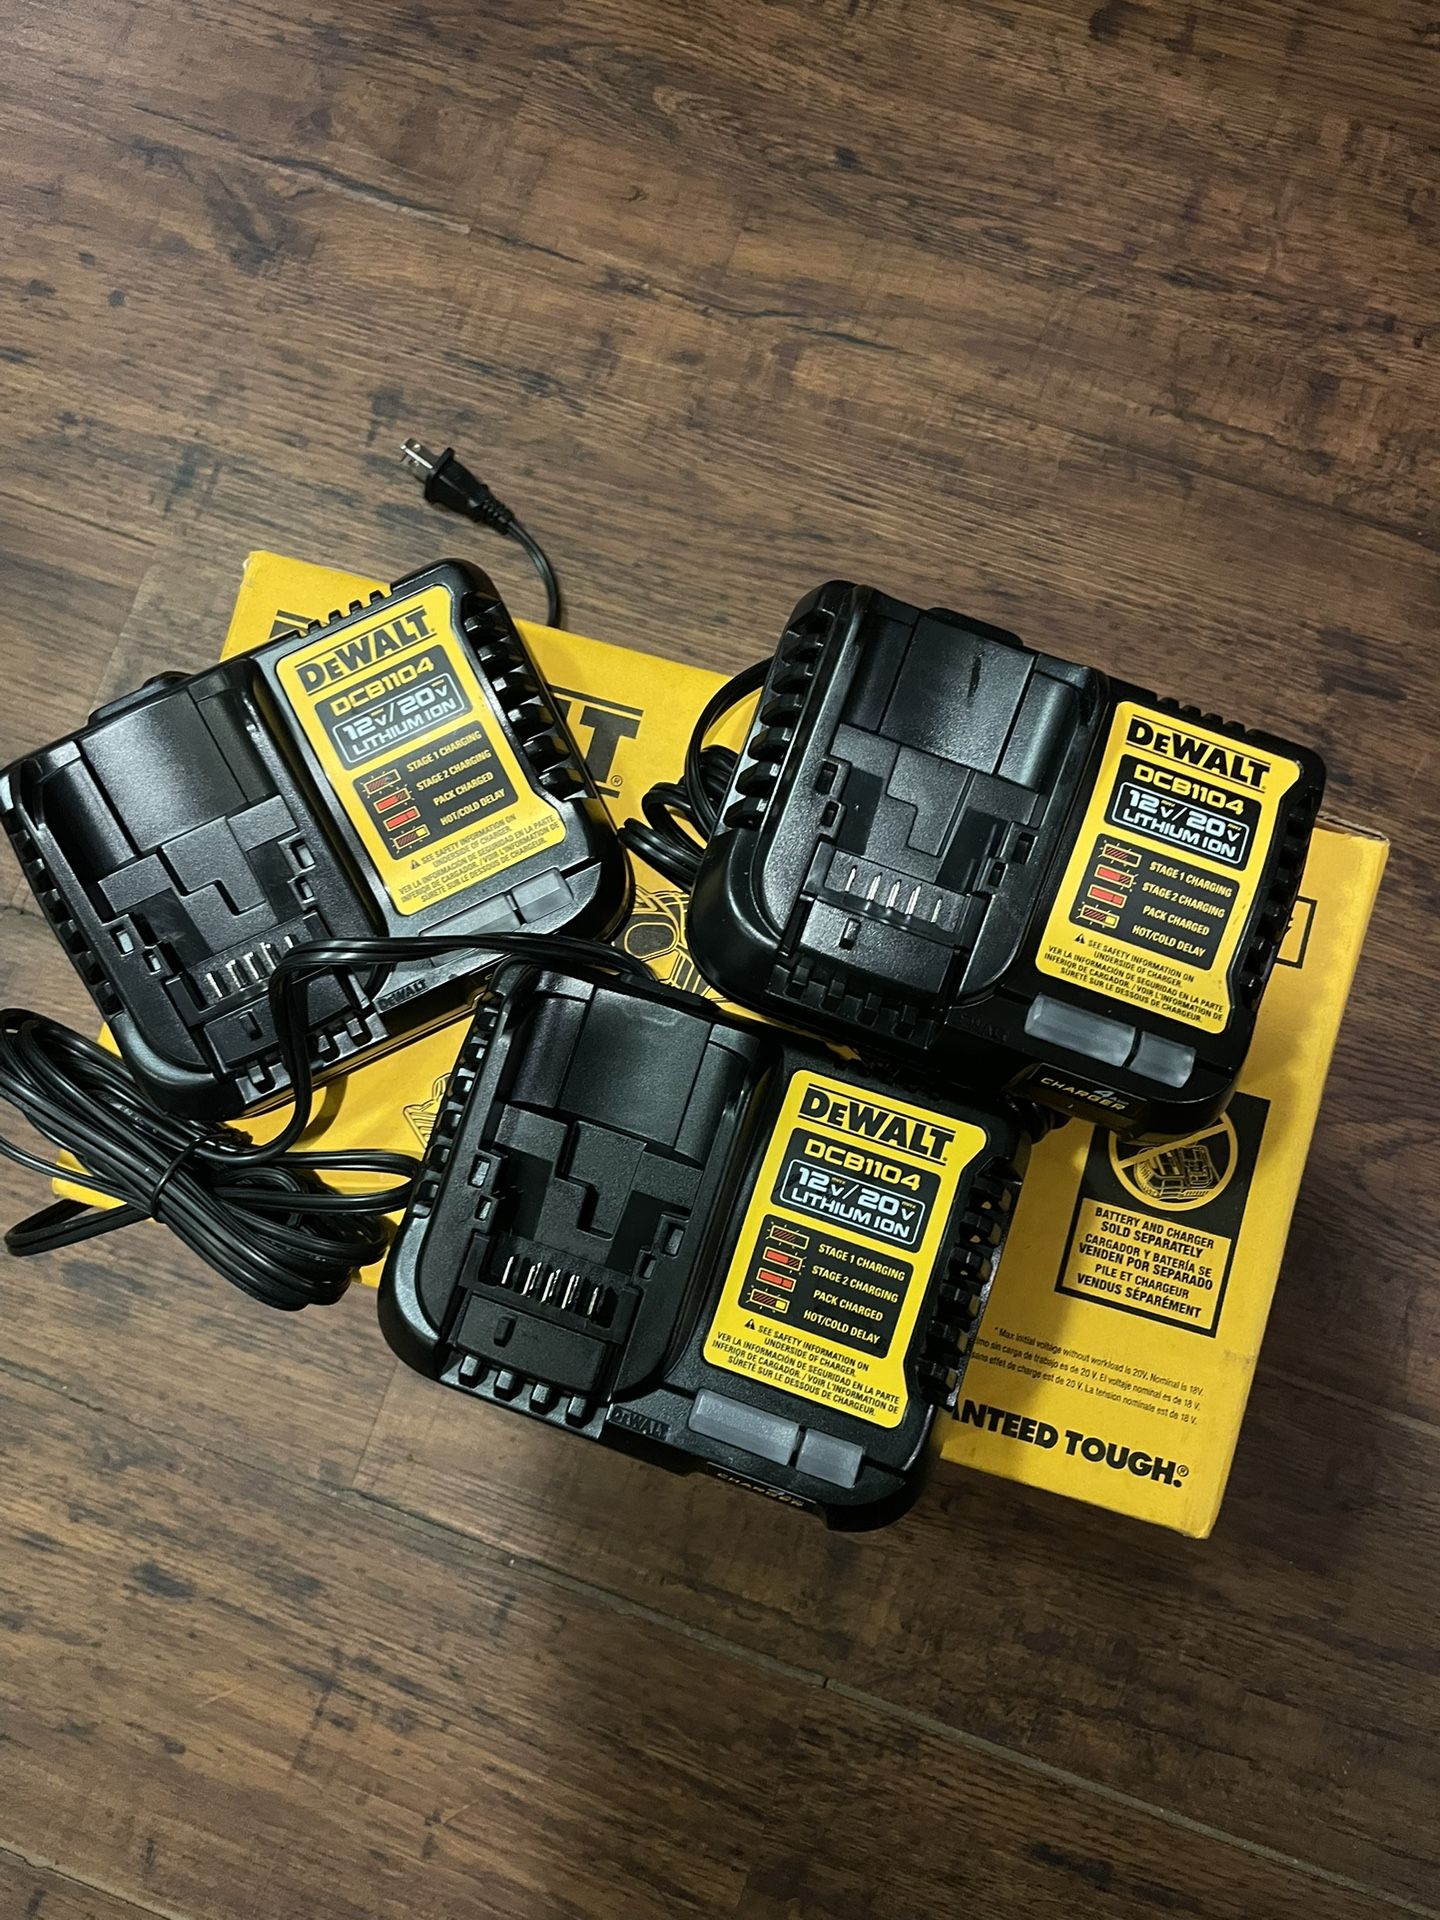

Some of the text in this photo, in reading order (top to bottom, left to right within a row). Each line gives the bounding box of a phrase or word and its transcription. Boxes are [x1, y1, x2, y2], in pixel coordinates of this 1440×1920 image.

[329, 655, 435, 716] DCB1104
[352, 697, 457, 756] LITHIUM ION
[406, 729, 482, 772] STAGE 1 CHARGING
[415, 748, 492, 791] STAGE 2 CHARGING
[432, 771, 494, 806] PACK CHARGED
[439, 788, 506, 826] HOT/COLD DELAY
[1133, 763, 1245, 815] DCB1104
[1122, 808, 1236, 857] LITHIUM ION
[1141, 882, 1225, 918] STAGE 2 CHARGING
[1149, 861, 1232, 898] STAGE 1 CHARGING
[1132, 924, 1205, 957] HOT/COLD DELAY
[1142, 905, 1209, 936] PACK CHARGED
[1040, 1077, 1126, 1110] CHARGER
[803, 1138, 922, 1192] DCB1104
[790, 1187, 910, 1238] LITHIUM ION
[1094, 1207, 1214, 1249] BATTERY AND CHARGER
[1084, 1233, 1212, 1278] CARGADOR Y BATERÍA SE
[1100, 1220, 1203, 1259] SOLD SEPARATELY
[817, 1243, 906, 1281] STAGE 1 CHARGING
[1077, 1242, 1213, 1290] VENDEN POR SEPARADO
[1094, 1263, 1189, 1299] PILE ET CHARGEUR
[811, 1265, 899, 1303] STAGE 2 CHARGING
[1075, 1273, 1202, 1318] VENDUS SÉPARÉMENT
[803, 1309, 880, 1344] HOT/COLD DELAY
[812, 1289, 883, 1322] PACK CHARGED
[716, 1331, 732, 1343] VER
[732, 1337, 742, 1347] LA
[796, 1360, 807, 1370] DE
[808, 1364, 851, 1386] SEGURIDAD
[852, 1380, 863, 1391] EN
[864, 1385, 874, 1395] LA
[875, 1389, 899, 1404] PARTE
[757, 1324, 869, 1371] SEE SAFETY INFORMATION ON
[763, 1337, 856, 1377] UNDERSIDE OF CHARGER.
[711, 1339, 746, 1358] INFERIOR
[746, 1352, 757, 1362] DE
[757, 1356, 801, 1378] CARGADOR.
[807, 1374, 826, 1387] VOIR
[826, 1381, 887, 1410] L'INFORMATION
[887, 1404, 898, 1414] DE
[757, 1366, 773, 1378] SUR
[774, 1372, 783, 1382] LE
[784, 1376, 820, 1395] DESSOUS
[821, 1390, 831, 1399] DE
[832, 1394, 875, 1416] CHARGEUR.
